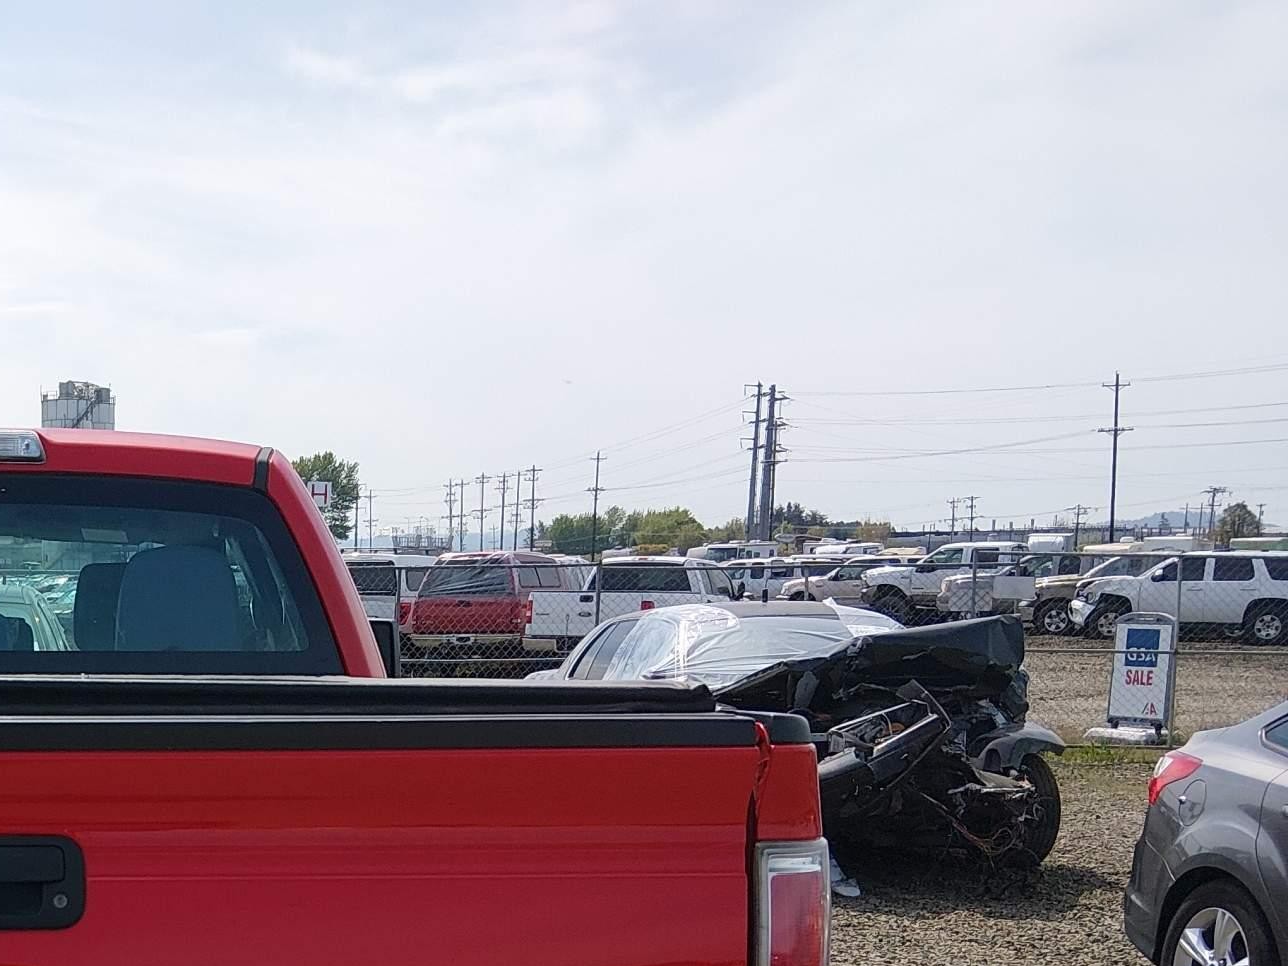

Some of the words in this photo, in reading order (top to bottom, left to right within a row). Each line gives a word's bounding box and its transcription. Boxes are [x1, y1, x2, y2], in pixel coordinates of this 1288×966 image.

[311, 483, 328, 505] H
[1127, 647, 1156, 662] GSA
[1125, 669, 1154, 686] SALE
